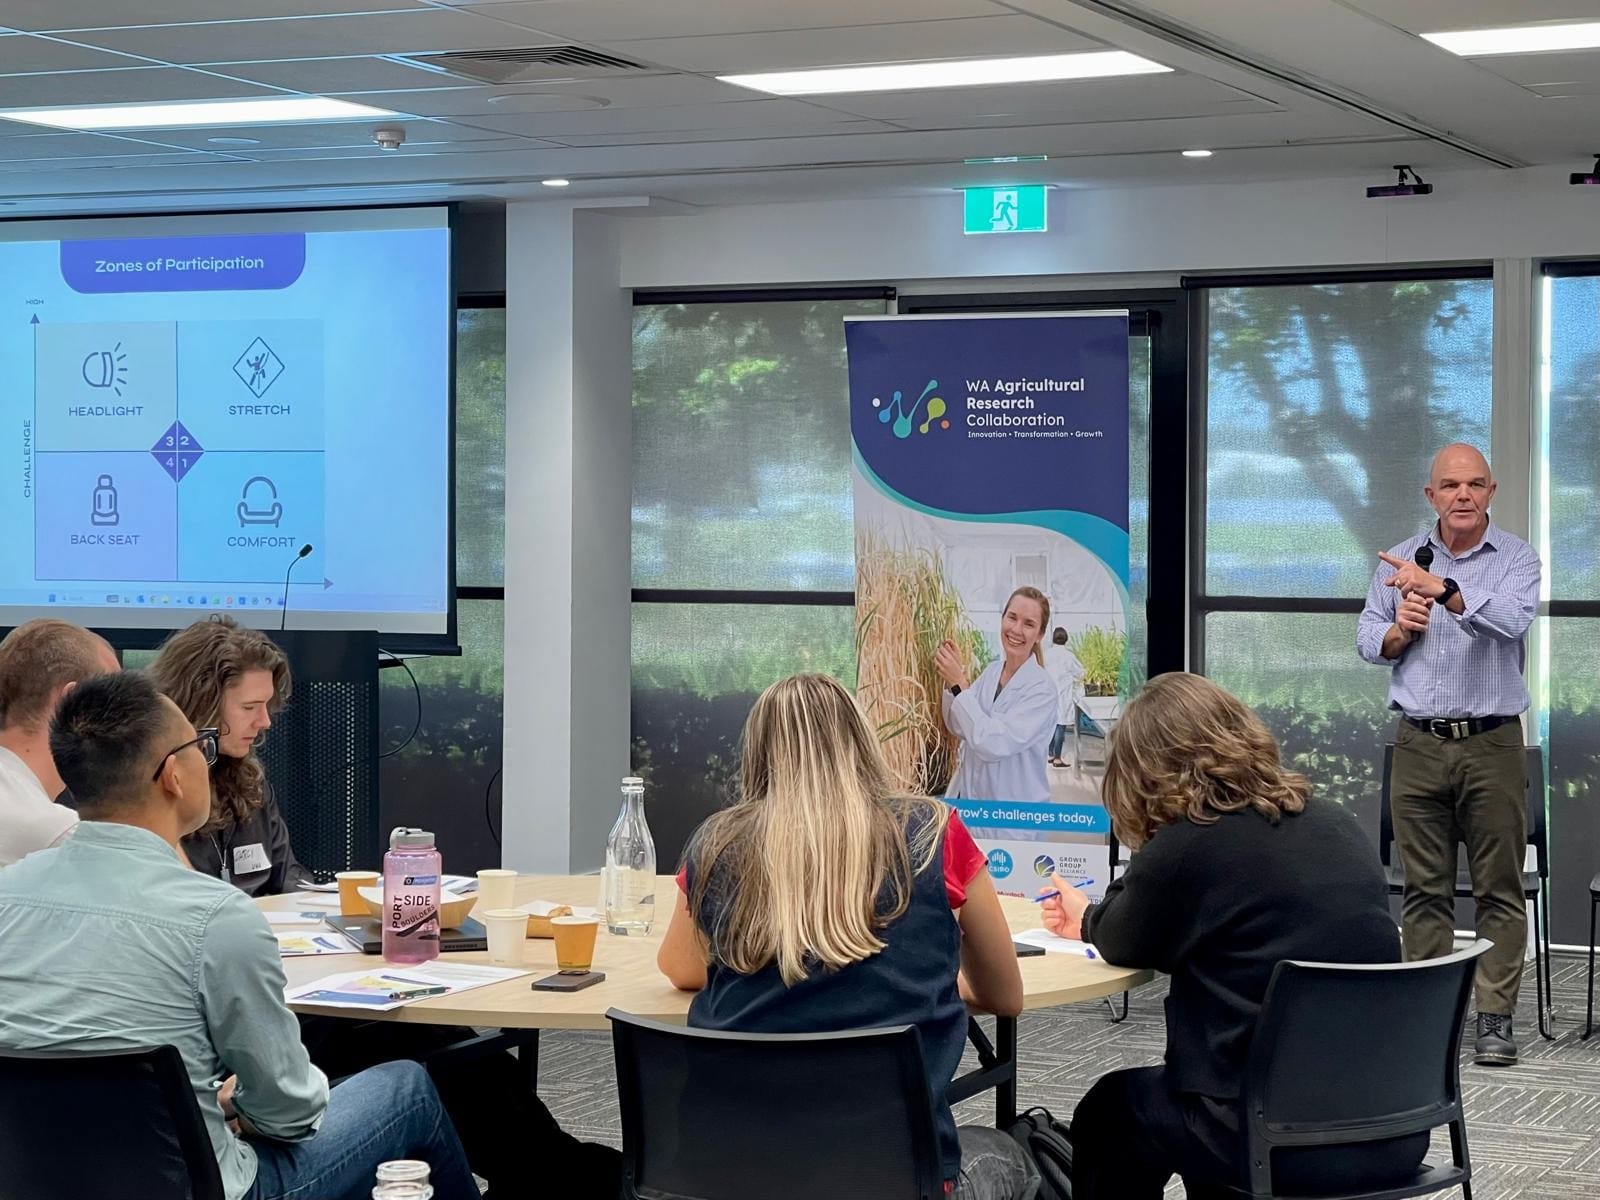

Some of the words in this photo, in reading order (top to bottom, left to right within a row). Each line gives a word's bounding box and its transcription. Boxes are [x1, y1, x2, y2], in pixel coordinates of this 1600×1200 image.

[94, 259, 143, 273] Zones
[147, 257, 163, 271] of
[165, 255, 264, 272] Participation
[966, 380, 990, 392] WA
[994, 378, 1085, 394] Agricultural
[966, 396, 1035, 409] Research
[68, 406, 144, 417] HEADLIGHT
[228, 404, 291, 416] STRETCH
[966, 413, 1065, 426] Collaboration
[967, 430, 1007, 438] Innovation
[1013, 430, 1068, 438] Transformation
[1075, 430, 1103, 438] Growth
[165, 436, 174, 447] 3
[180, 435, 189, 446] 2
[23, 419, 31, 498] CHALLENGE
[165, 457, 174, 468] 4
[181, 458, 188, 469] 1
[70, 535, 105, 546] BACK
[108, 535, 140, 546] SEAT
[227, 537, 296, 548] COMFORT
[957, 807, 989, 819] row's
[992, 809, 1055, 824] challenges
[1058, 812, 1096, 827] today.
[404, 895, 431, 906] SIDE
[392, 896, 402, 929] PORT
[401, 905, 435, 928] BOULDERS
